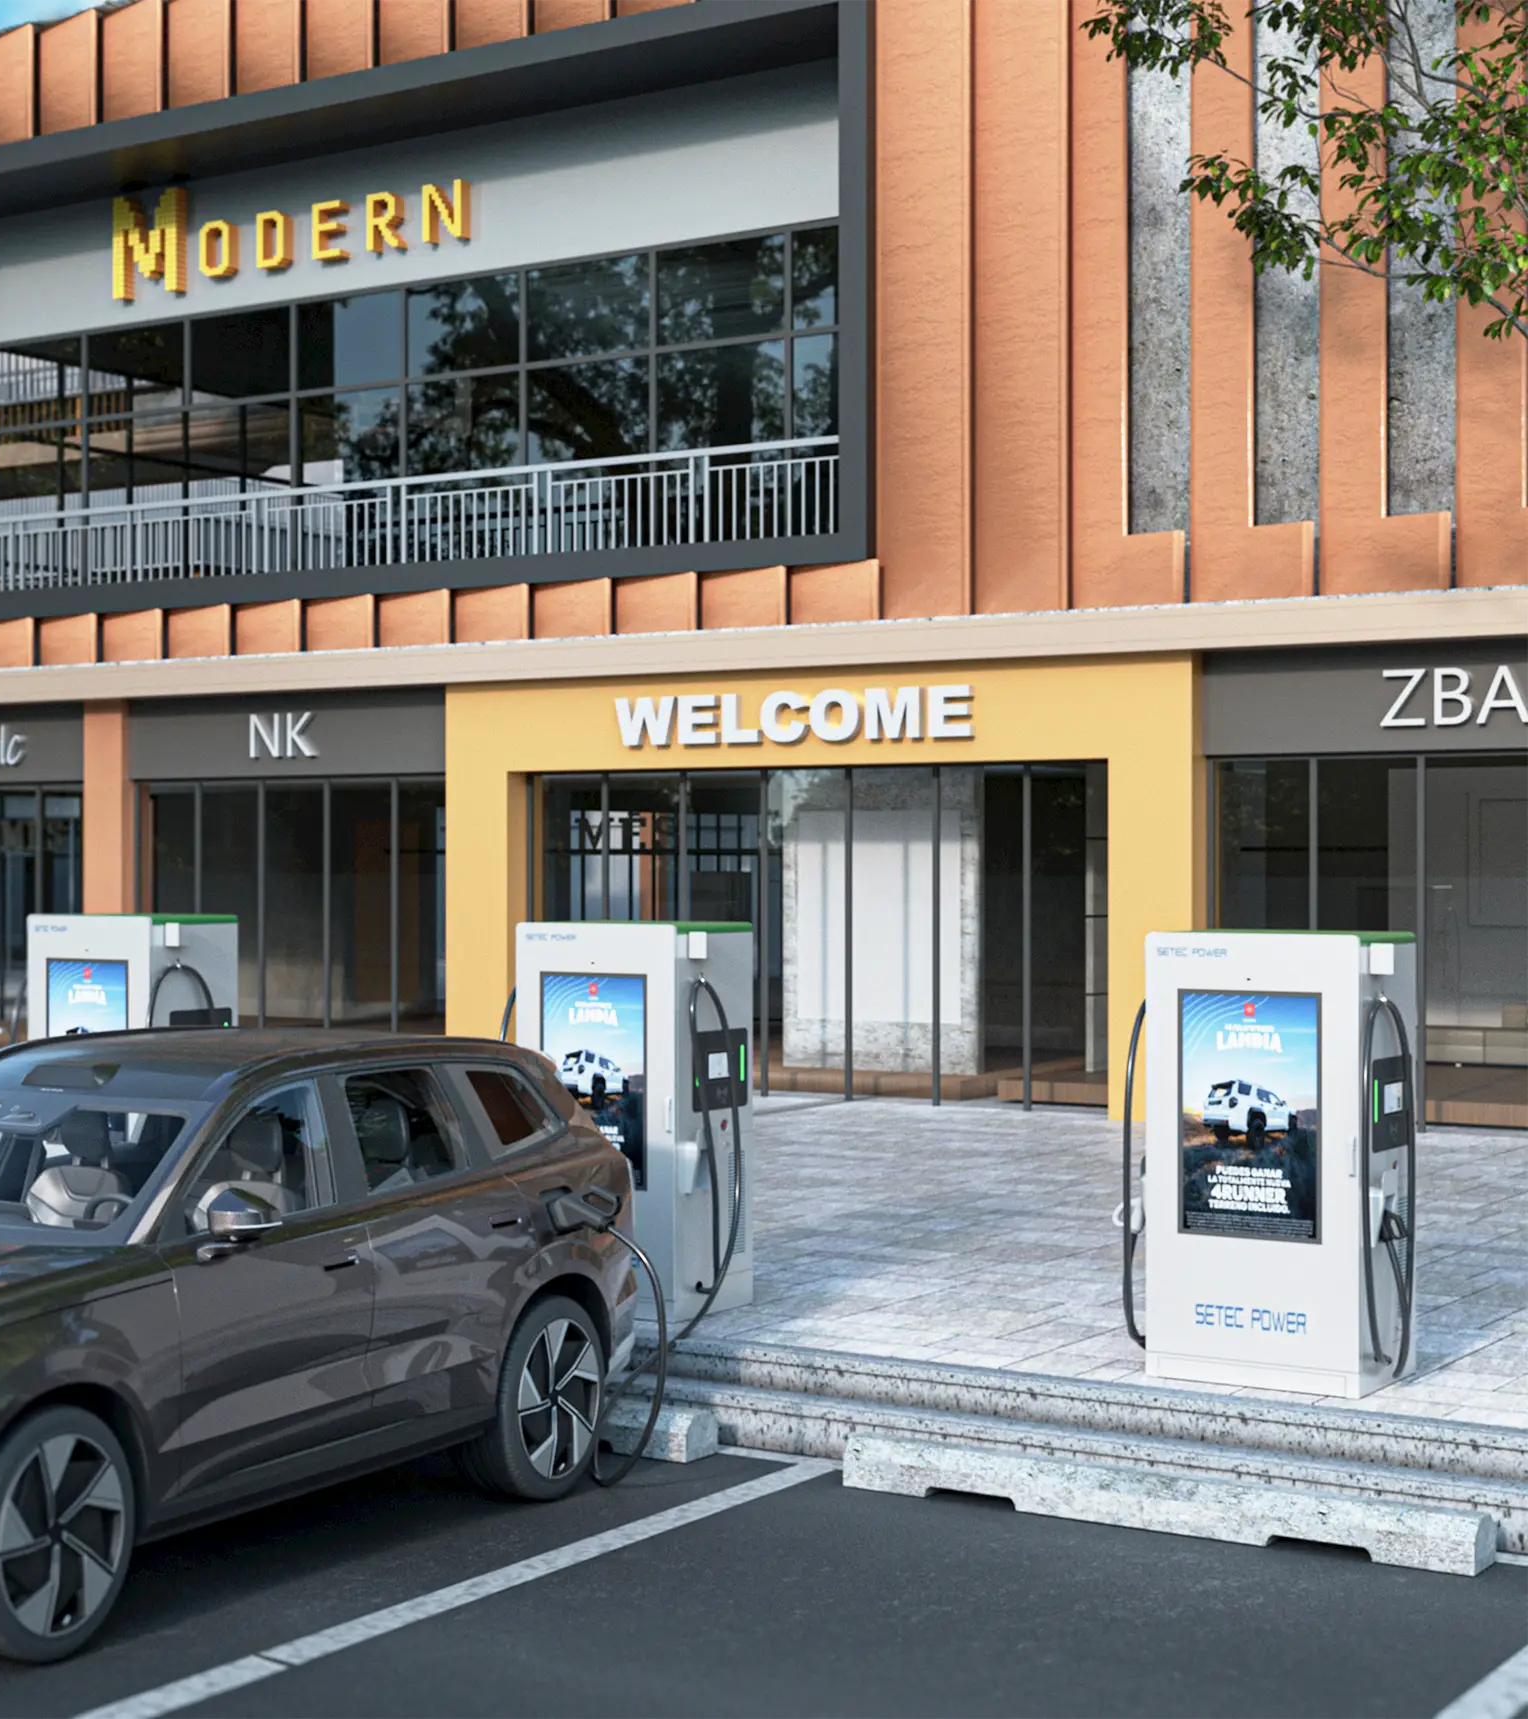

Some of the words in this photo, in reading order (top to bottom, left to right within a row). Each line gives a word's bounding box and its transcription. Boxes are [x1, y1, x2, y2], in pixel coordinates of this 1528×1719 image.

[112, 178, 471, 301] MODERN
[614, 684, 974, 749] WELCOME
[1379, 664, 1528, 727] ZBA
[249, 711, 318, 758] NK
[1157, 947, 1188, 957] SETEC
[1192, 948, 1228, 958] POWER
[1210, 1183, 1288, 1205] 4RUNNER
[1195, 1302, 1244, 1329] SETEC
[1251, 1308, 1307, 1335] POWER
